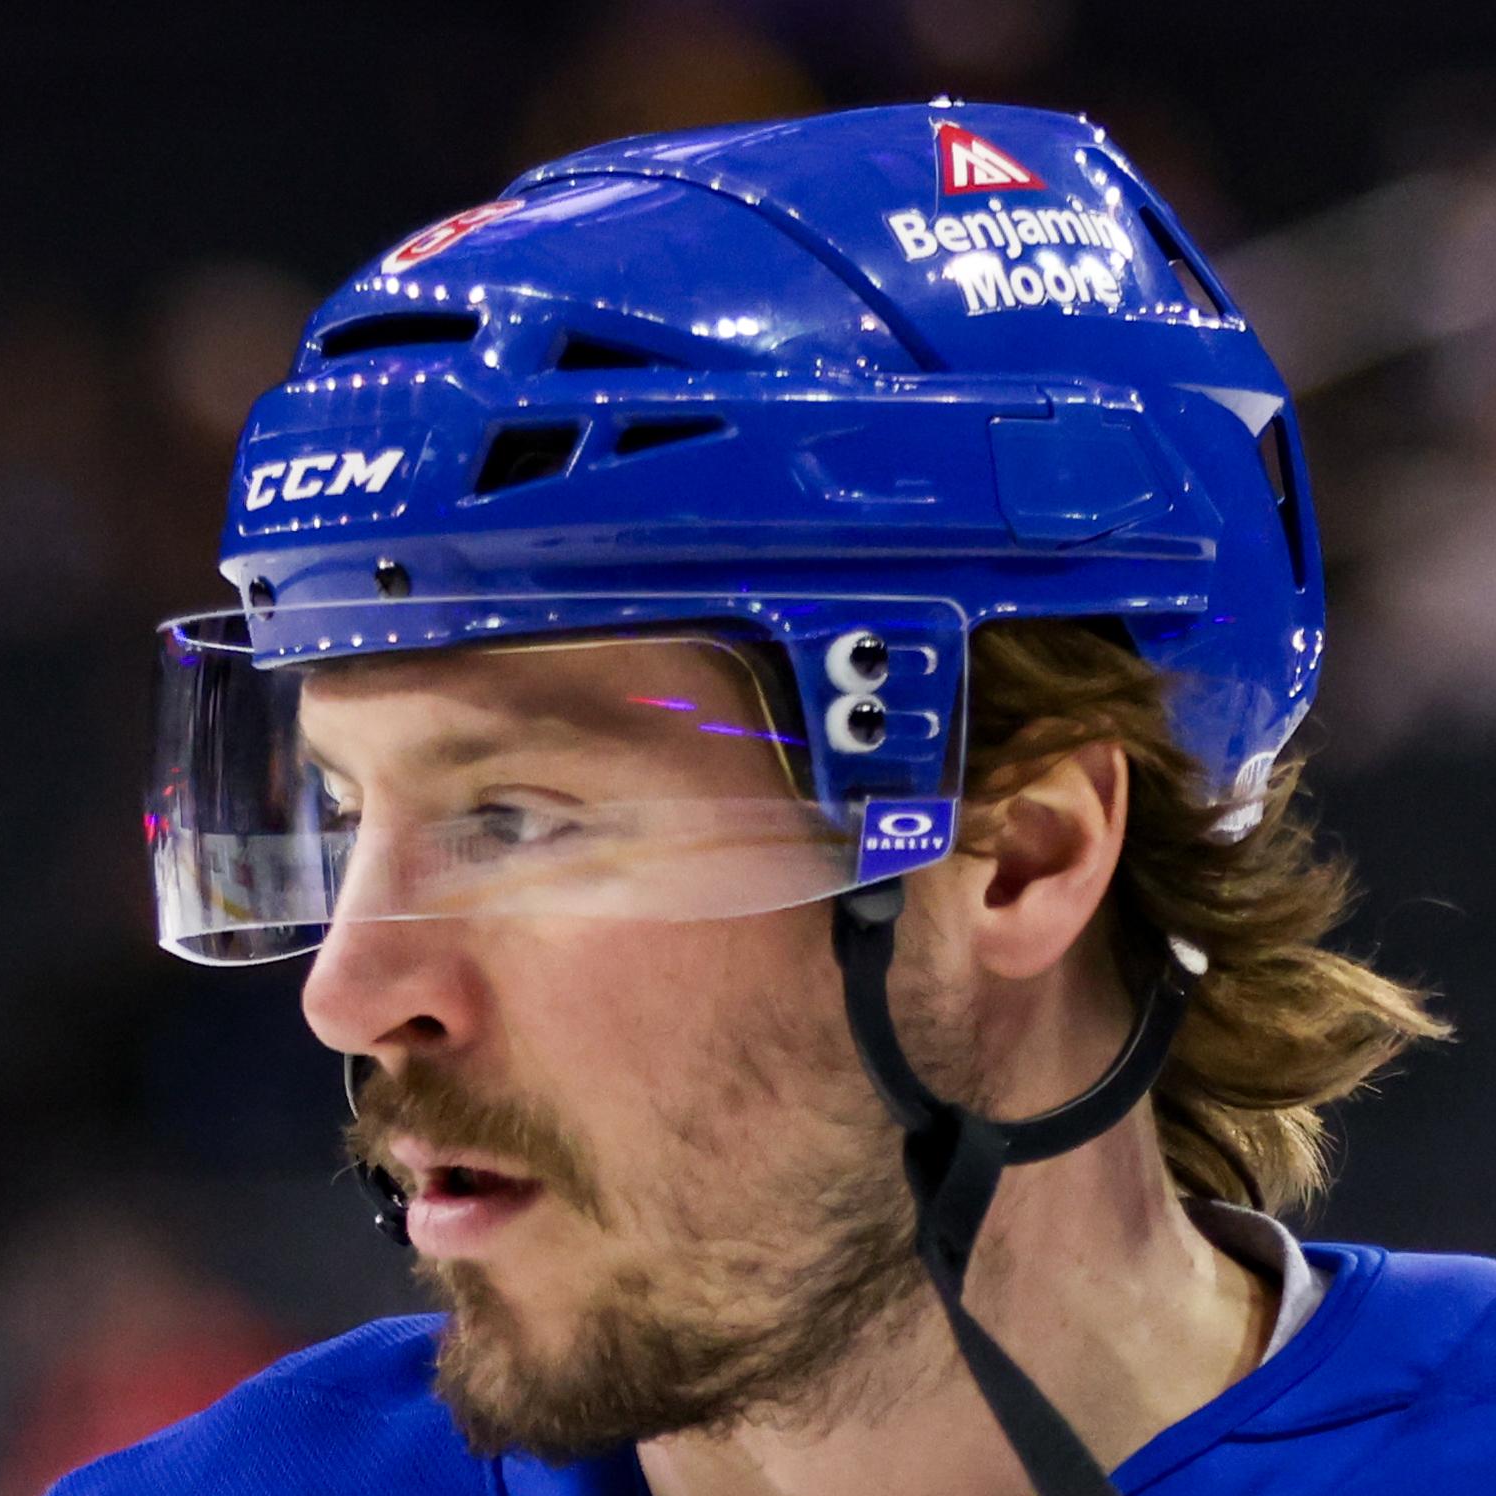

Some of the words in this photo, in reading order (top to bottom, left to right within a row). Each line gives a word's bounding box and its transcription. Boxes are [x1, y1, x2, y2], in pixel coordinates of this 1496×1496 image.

[888, 198, 1134, 262] Benjamin
[958, 256, 1122, 316] Moore
[246, 450, 404, 512] CCM
